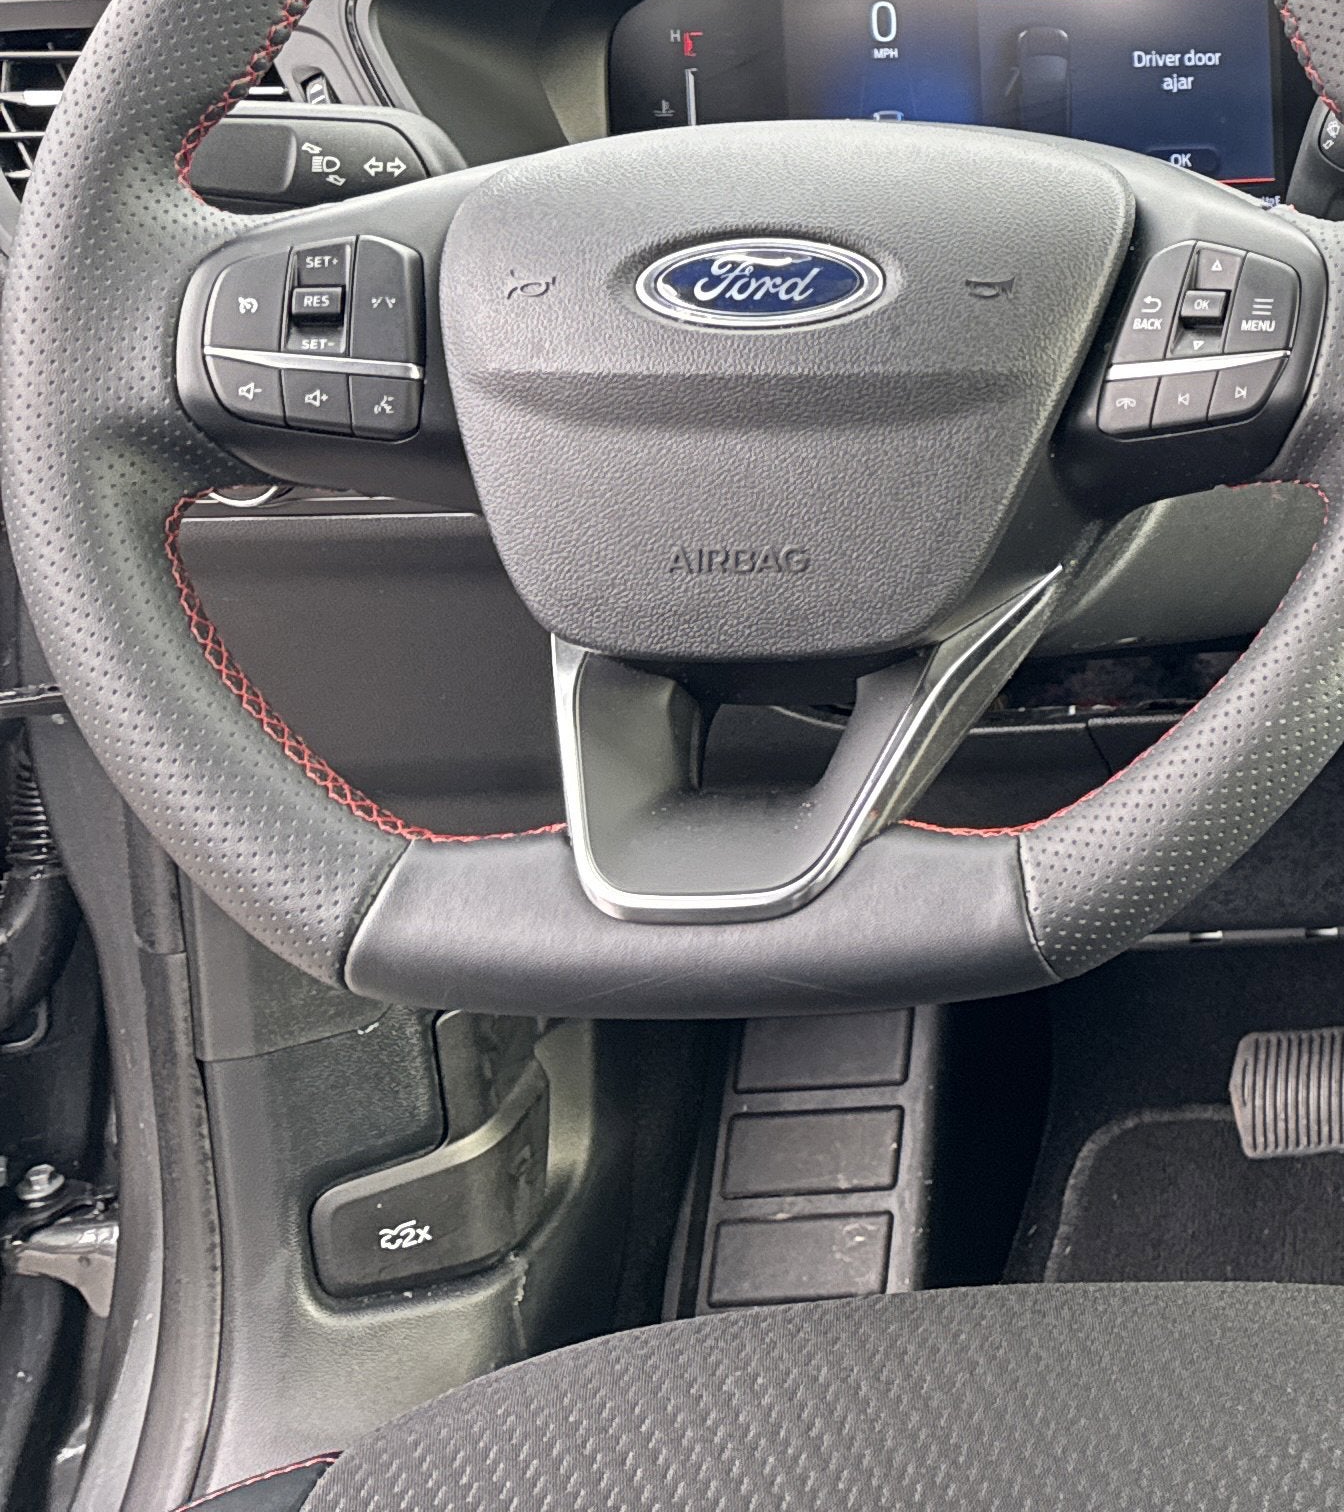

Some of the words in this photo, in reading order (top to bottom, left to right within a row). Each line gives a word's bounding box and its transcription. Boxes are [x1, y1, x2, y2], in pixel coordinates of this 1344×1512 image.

[870, 0, 897, 43] 0
[670, 29, 681, 43] H
[872, 47, 899, 60] MPH
[1132, 50, 1181, 67] Driver
[1183, 49, 1222, 66] door
[1162, 73, 1195, 92] ajar
[1169, 153, 1193, 168] OK
[693, 250, 824, 302] Ford
[303, 295, 330, 307] RES
[1193, 299, 1210, 311] OK
[1132, 317, 1162, 330] BACK
[1240, 319, 1276, 332] MENU
[668, 545, 811, 574] AIRBAG
